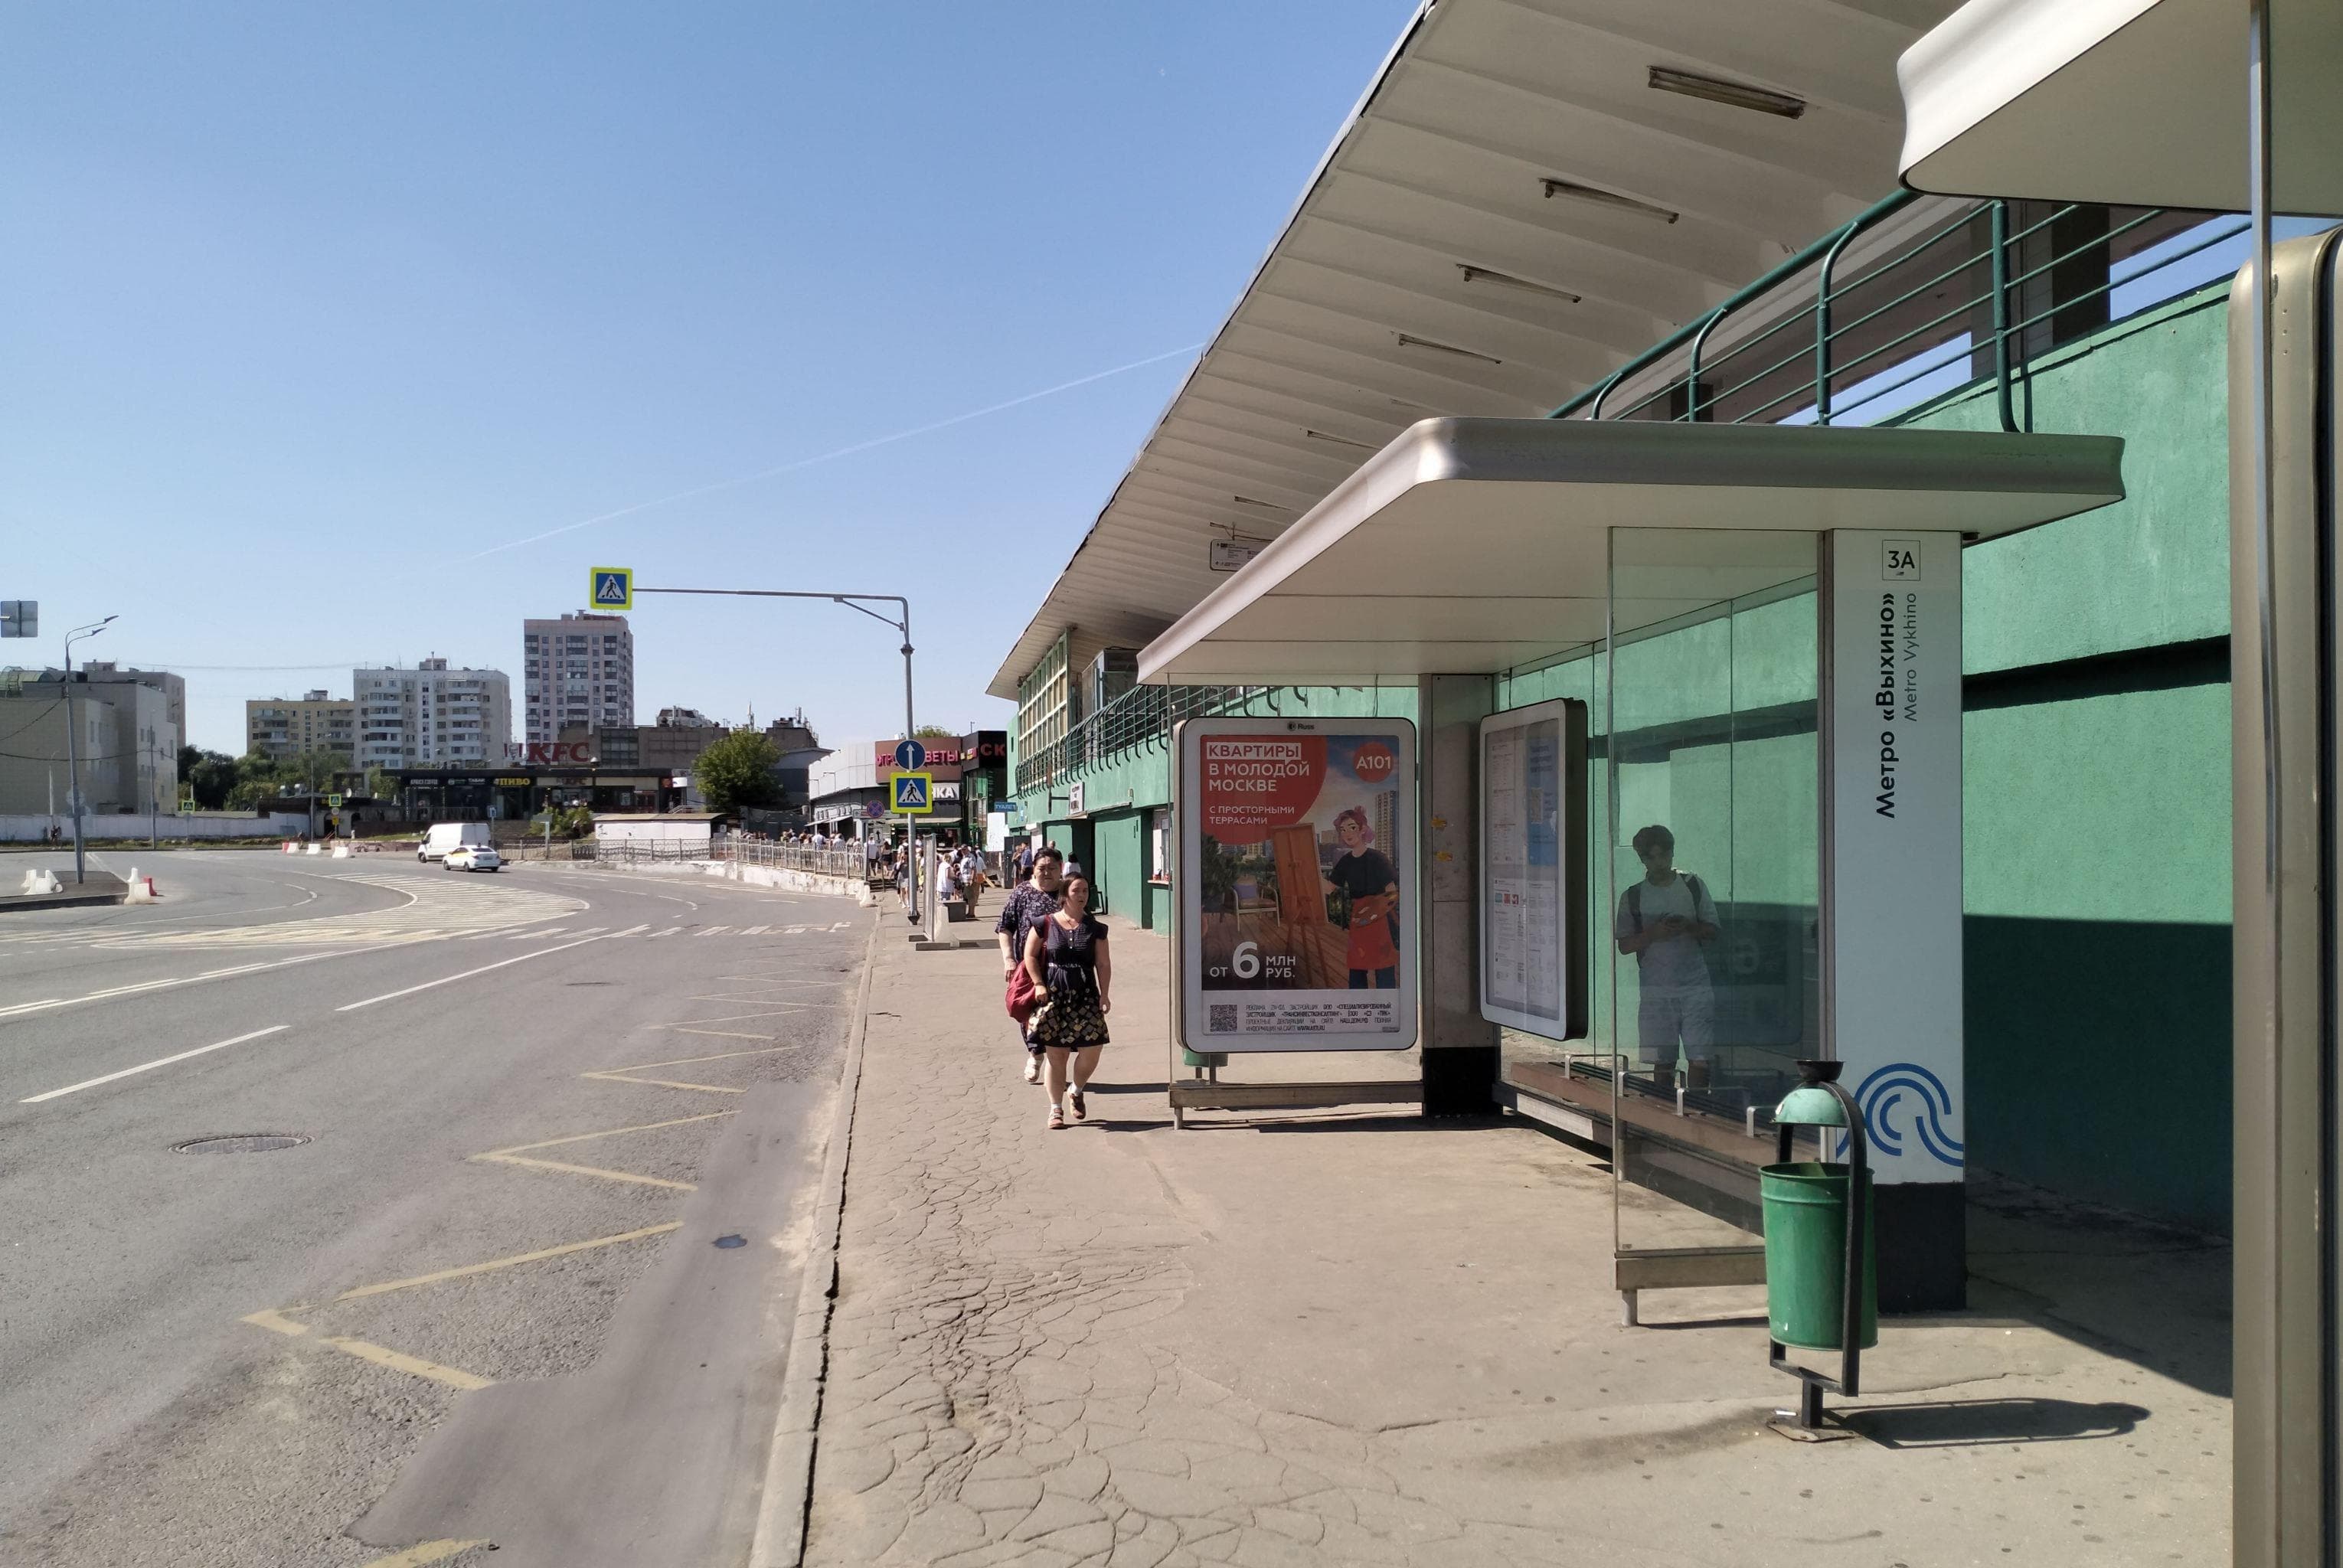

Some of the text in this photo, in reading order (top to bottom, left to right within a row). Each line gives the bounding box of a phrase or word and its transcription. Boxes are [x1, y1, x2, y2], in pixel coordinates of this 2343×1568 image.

[1903, 593, 1920, 721] Metro Vykhino
[1875, 593, 1899, 818] Метро «Выхино»
[527, 742, 589, 764] KFC
[1208, 745, 1299, 757] КВАРТИРЫ
[1209, 762, 1310, 778] В МОЛОДОЙ
[1209, 779, 1277, 792] МОСКВЕ
[1210, 816, 1267, 825] ТЕРРАСАМИ
[1209, 941, 1296, 978] ОТ 6 МЛН
[1266, 968, 1296, 978] РУБ.
